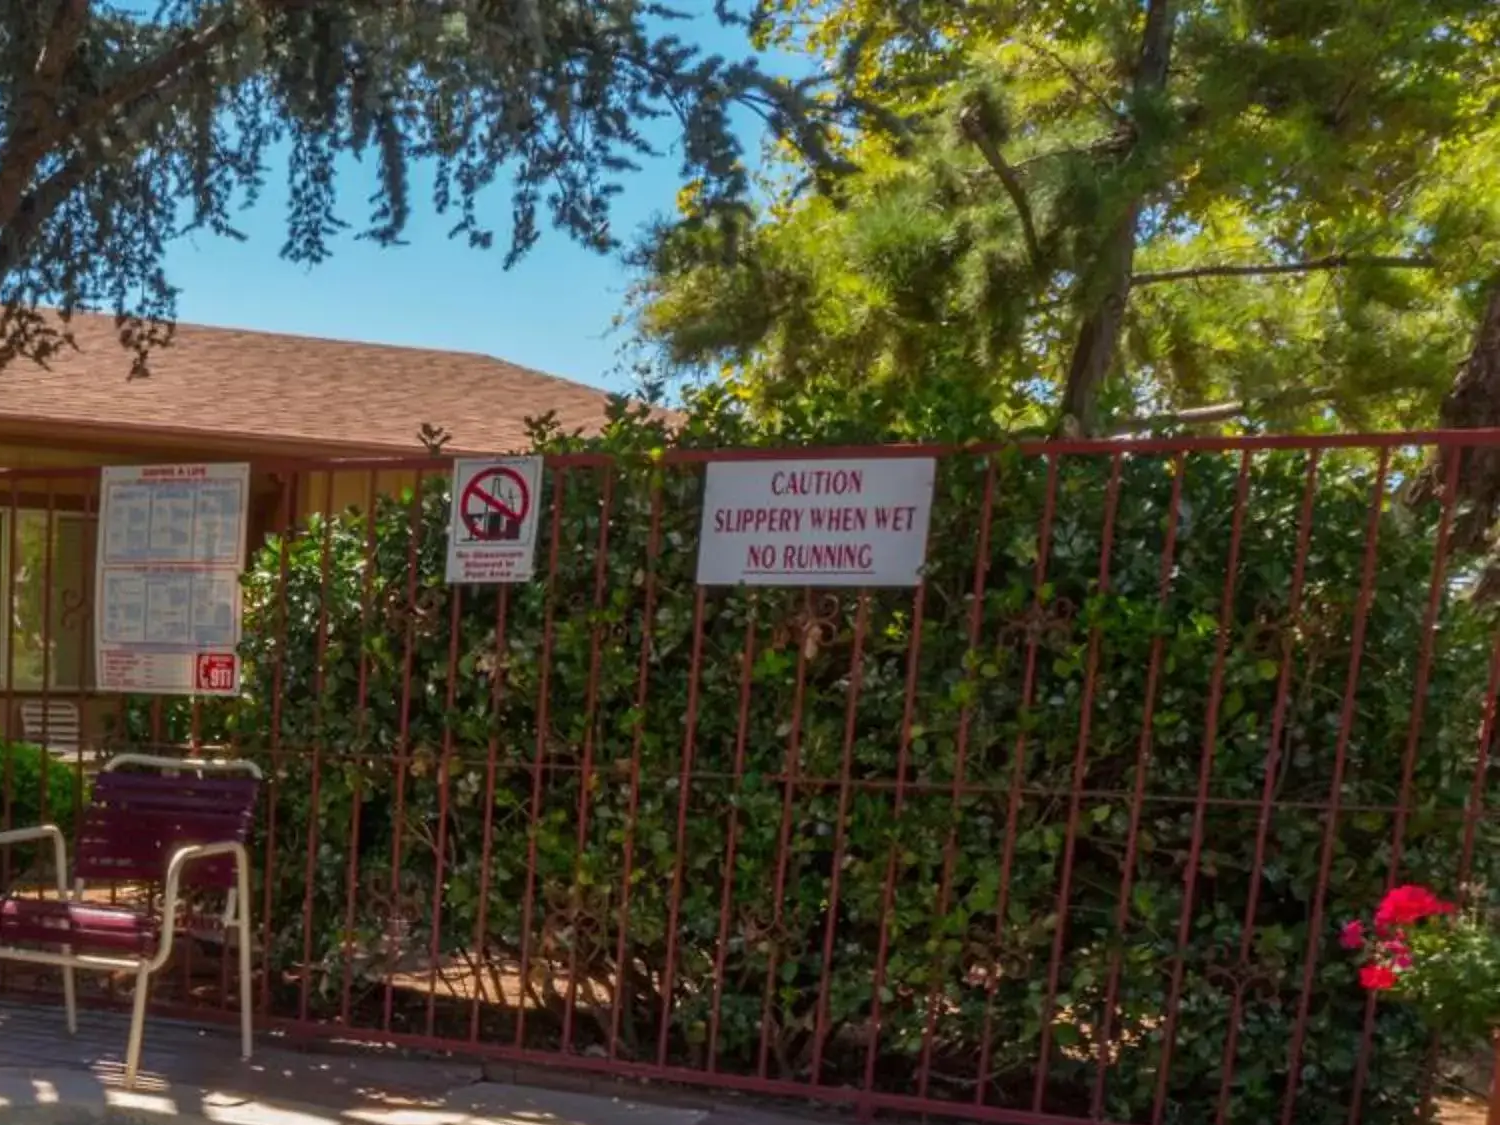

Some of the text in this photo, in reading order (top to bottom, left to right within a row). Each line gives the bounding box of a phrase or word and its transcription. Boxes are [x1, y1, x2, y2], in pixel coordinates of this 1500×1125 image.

[771, 470, 863, 496] CAUTION
[713, 506, 916, 533] SLIPPERY WHEN WET
[747, 544, 874, 569] NO RUNNING
[211, 669, 232, 687] 911
